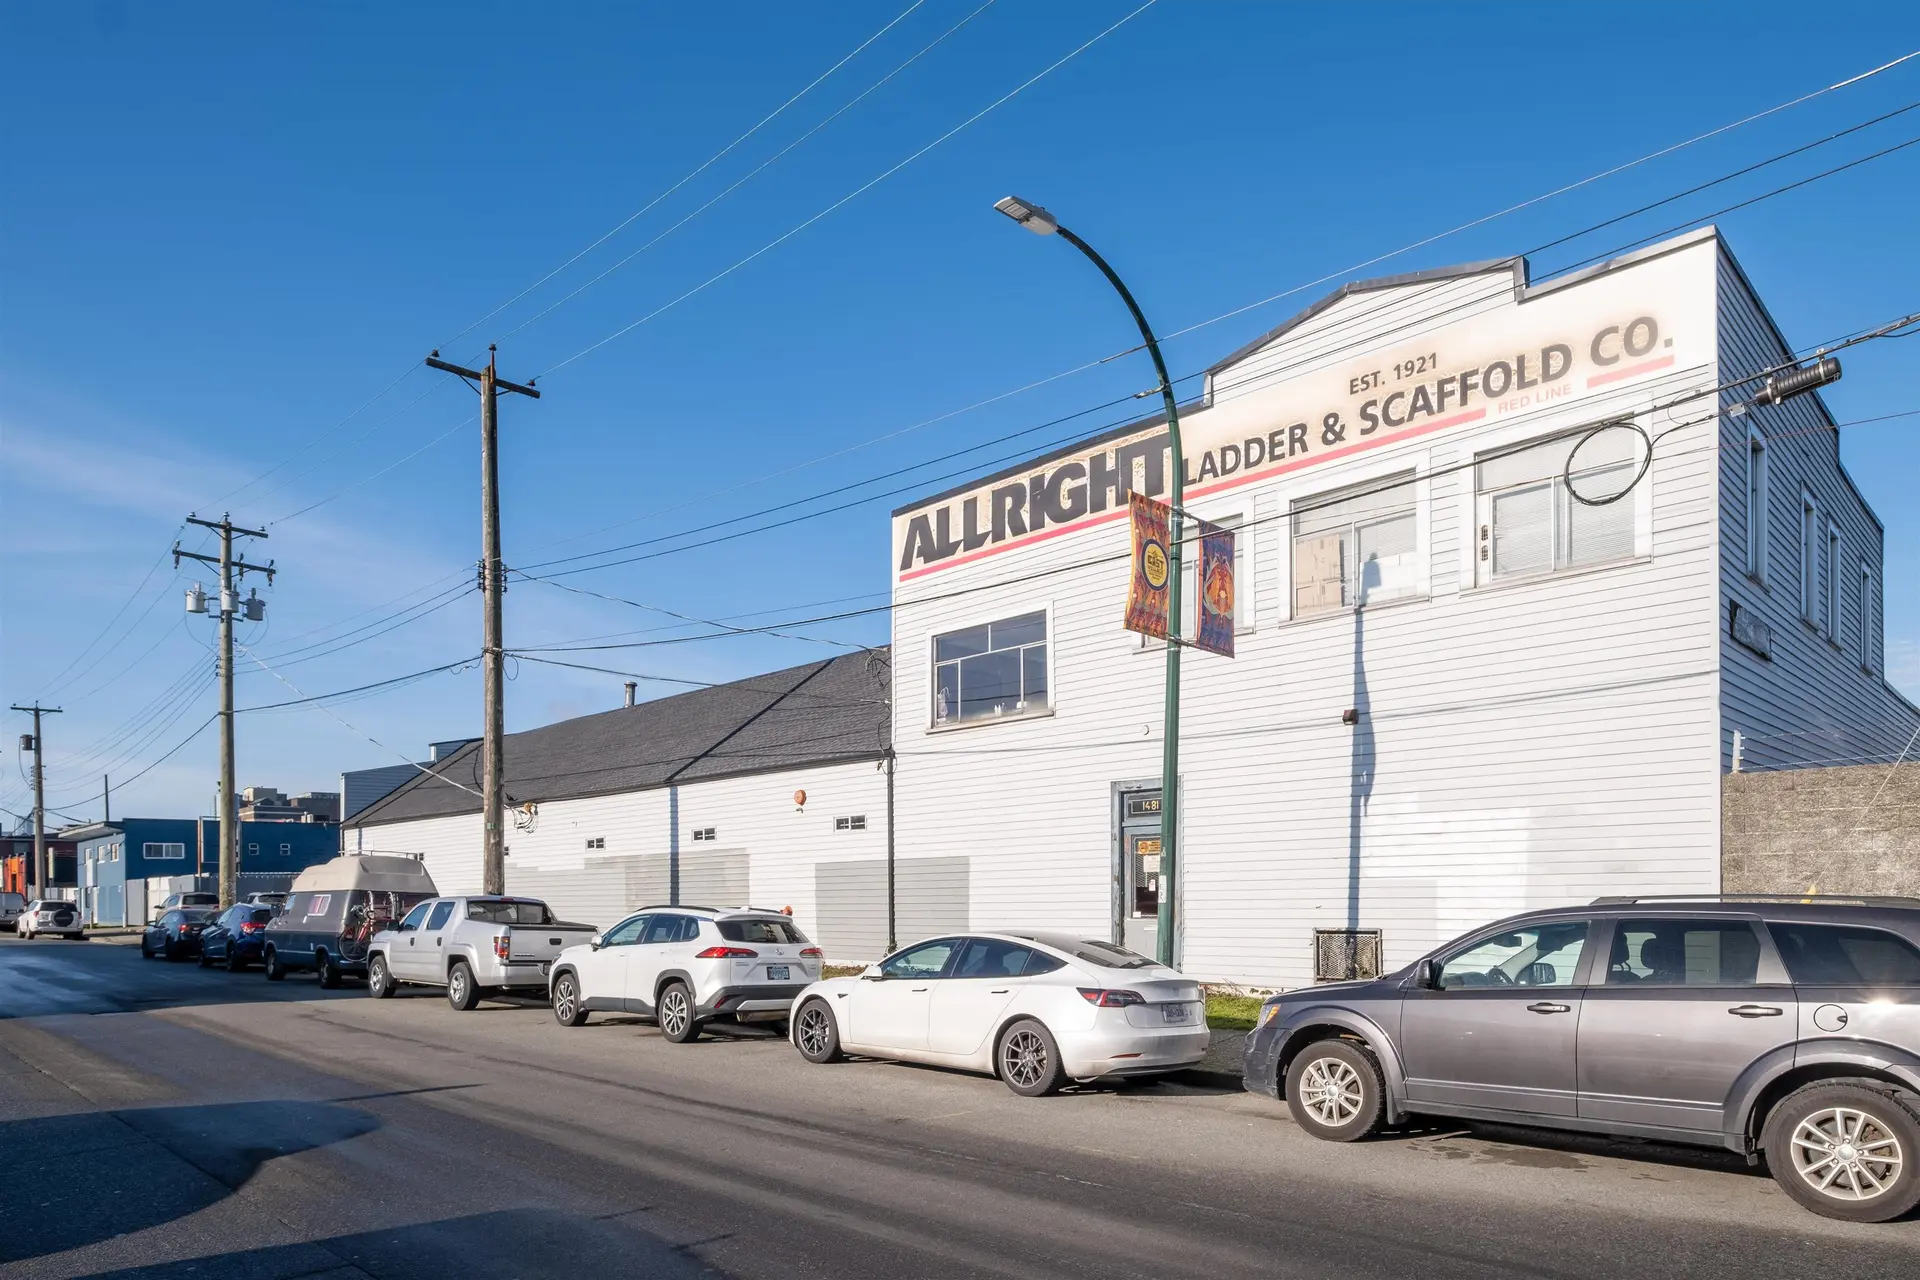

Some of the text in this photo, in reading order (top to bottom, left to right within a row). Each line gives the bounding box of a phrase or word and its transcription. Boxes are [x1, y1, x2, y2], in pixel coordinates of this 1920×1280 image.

[1349, 352, 1438, 396] EST. 1921
[1498, 383, 1572, 414] RED LINE
[900, 316, 1674, 571] ALLRIGHT LADDER & SCAFFOLD CO.
[1142, 800, 1159, 811] 1481
